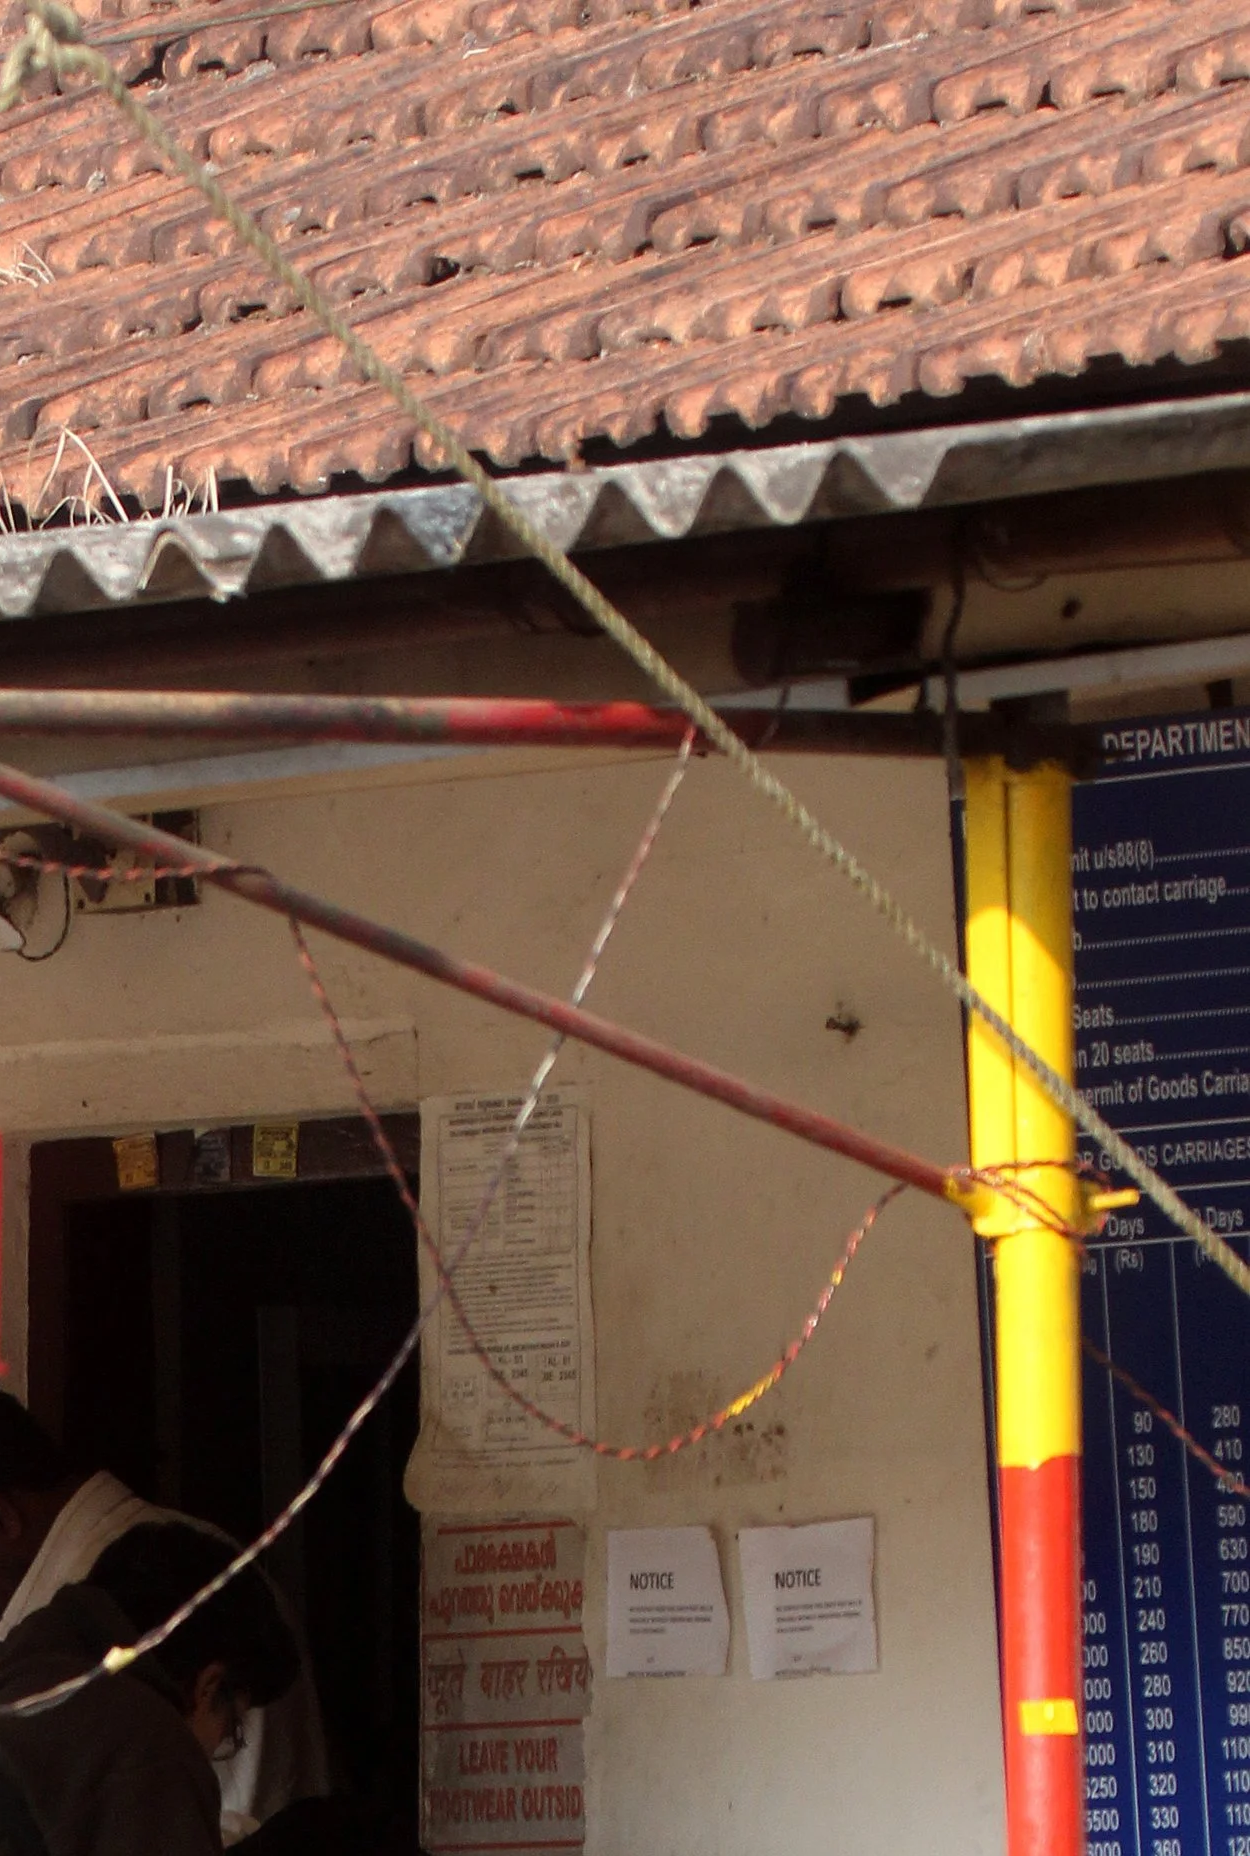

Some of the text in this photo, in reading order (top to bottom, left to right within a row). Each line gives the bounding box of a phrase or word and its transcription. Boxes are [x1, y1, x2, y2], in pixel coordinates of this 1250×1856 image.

[1103, 881, 1160, 908] contact
[1164, 874, 1226, 904] carriage
[1092, 1041, 1110, 1067] 20
[1114, 1040, 1154, 1065] seats
[1148, 1073, 1198, 1101] Goods
[1134, 1405, 1241, 1433] 90 280
[1128, 1438, 1243, 1466] 130 410
[1130, 1477, 1156, 1499] 150
[1132, 1505, 1246, 1532] 180 590
[1134, 1538, 1248, 1565] 190 630
[629, 1571, 675, 1591] NOTICE
[774, 1567, 822, 1590] NOTICE
[1135, 1570, 1250, 1598] 210 700
[1139, 1609, 1165, 1631] 240
[1221, 1604, 1250, 1627] 770
[1141, 1642, 1167, 1664] 260
[1144, 1675, 1171, 1697] 280
[1146, 1708, 1173, 1730] 300
[459, 1736, 558, 1775] LEAVE YOUR
[1148, 1740, 1175, 1763] 310
[1150, 1774, 1176, 1796] 320
[1152, 1806, 1178, 1828] 330
